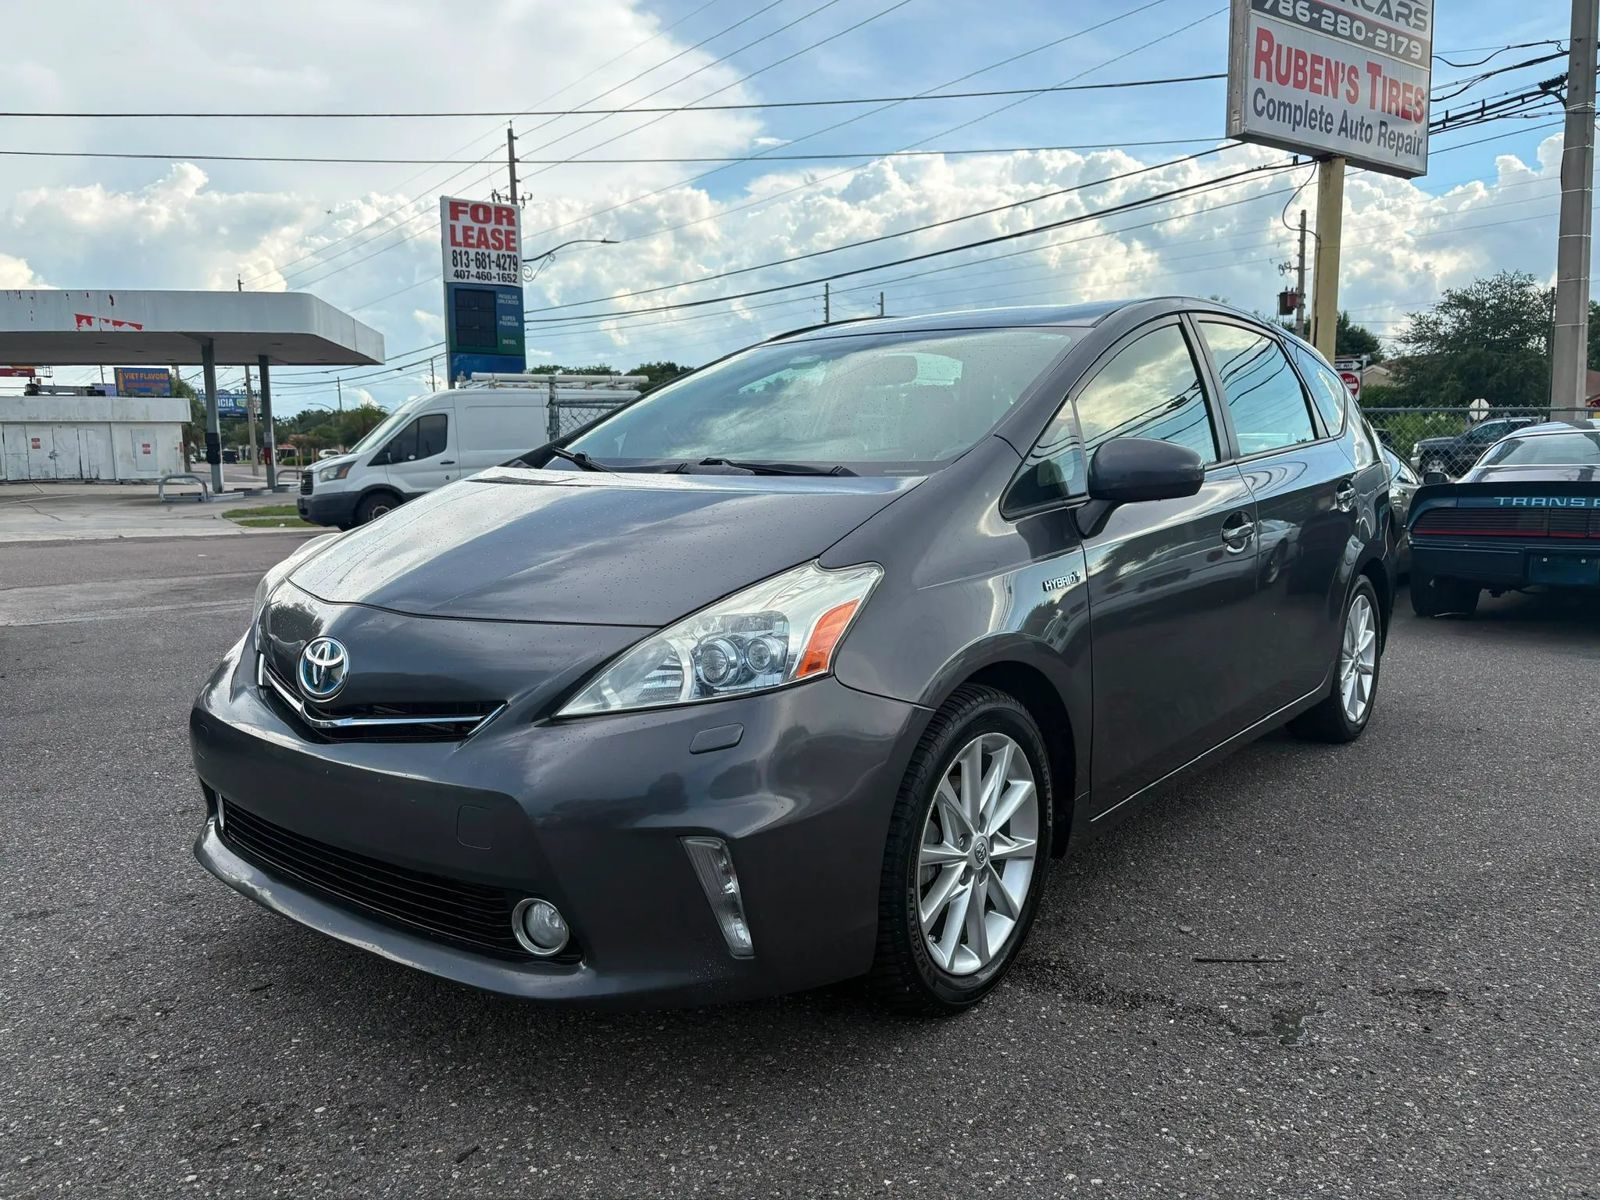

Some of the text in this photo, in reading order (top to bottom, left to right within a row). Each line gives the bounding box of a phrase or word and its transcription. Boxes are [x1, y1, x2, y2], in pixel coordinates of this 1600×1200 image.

[1338, 0, 1429, 33] CARS
[1253, 26, 1425, 125] RUBEN'S TIRES
[1253, 87, 1424, 157] Complete Auto Repair
[449, 201, 516, 226] FOR
[449, 224, 517, 252] LEASE
[452, 249, 518, 272] 813-681-4279
[453, 269, 518, 284] 407-460-1652
[1494, 497, 1586, 507] TRANS
[1044, 574, 1076, 591] HYBRID
